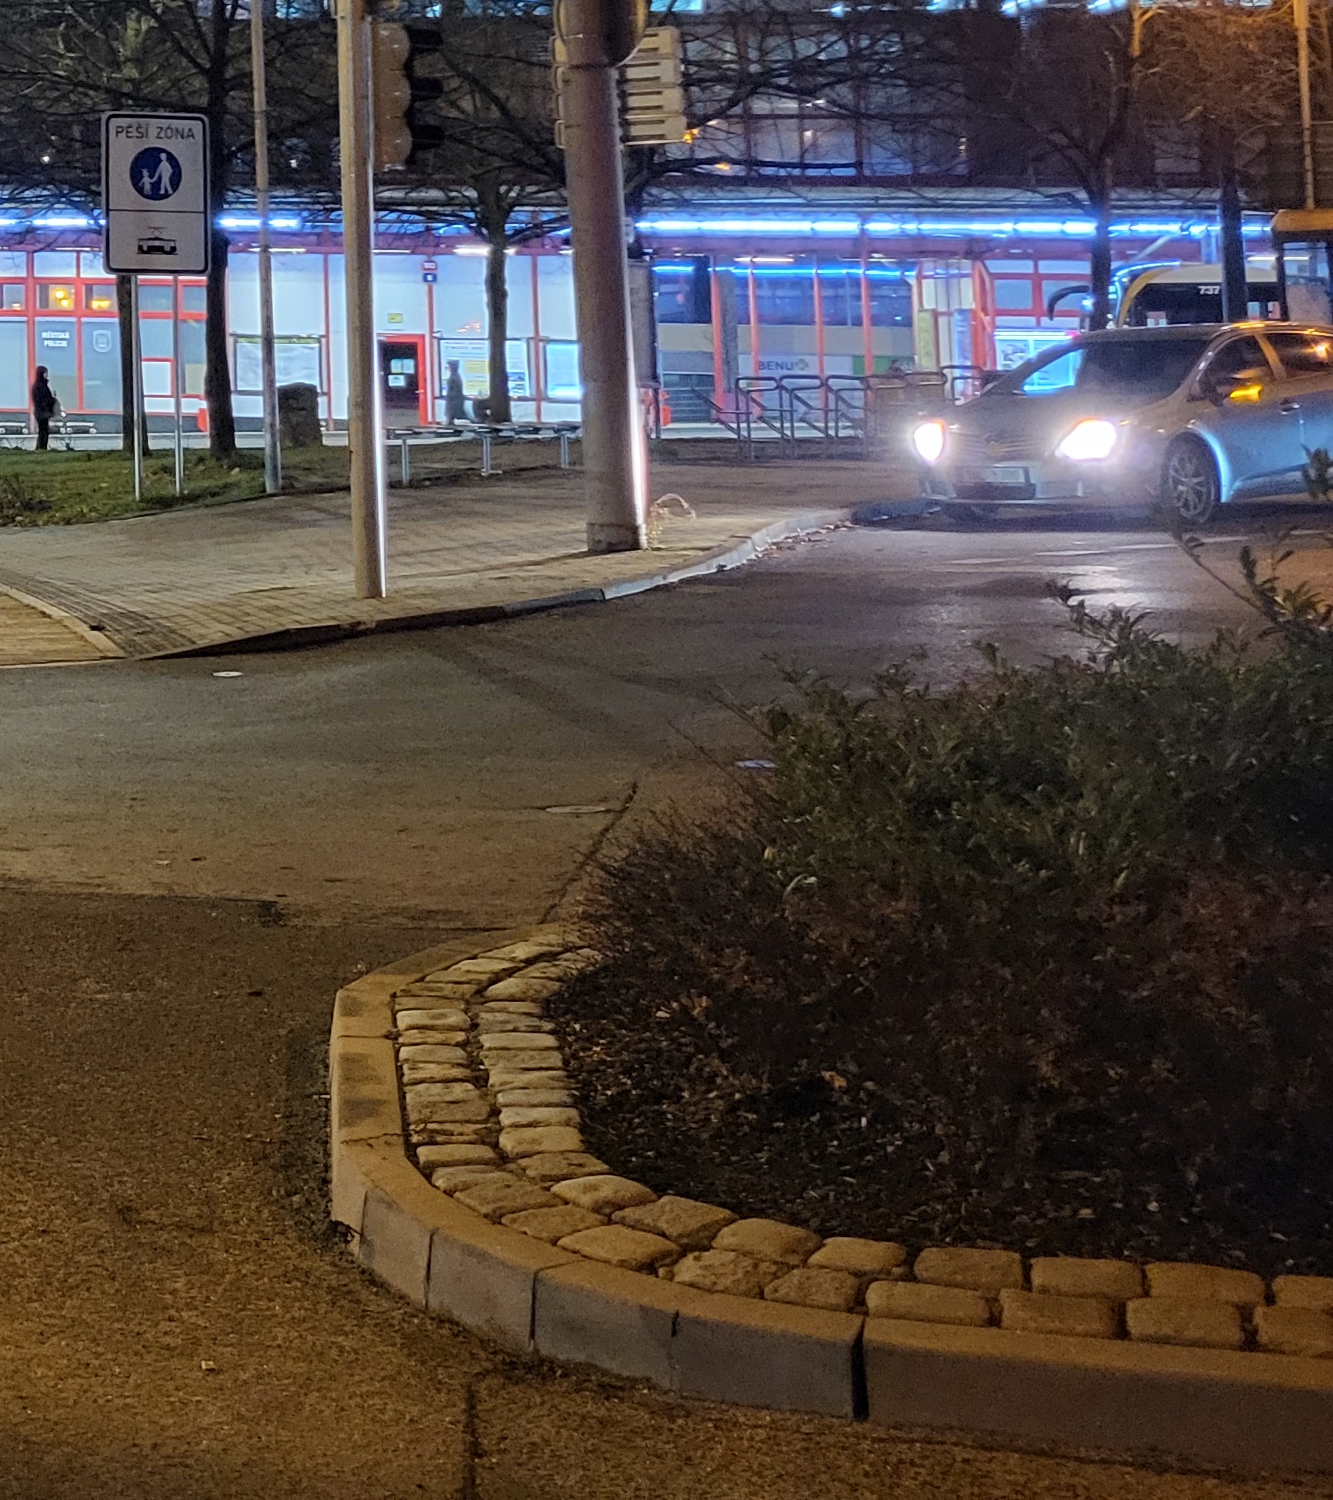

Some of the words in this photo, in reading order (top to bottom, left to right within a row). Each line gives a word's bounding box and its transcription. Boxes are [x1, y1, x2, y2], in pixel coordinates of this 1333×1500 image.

[115, 123, 150, 140] PĚŠÍ
[155, 124, 196, 140] ZÓNA
[1198, 285, 1221, 295] 737
[758, 361, 794, 371] BENU
